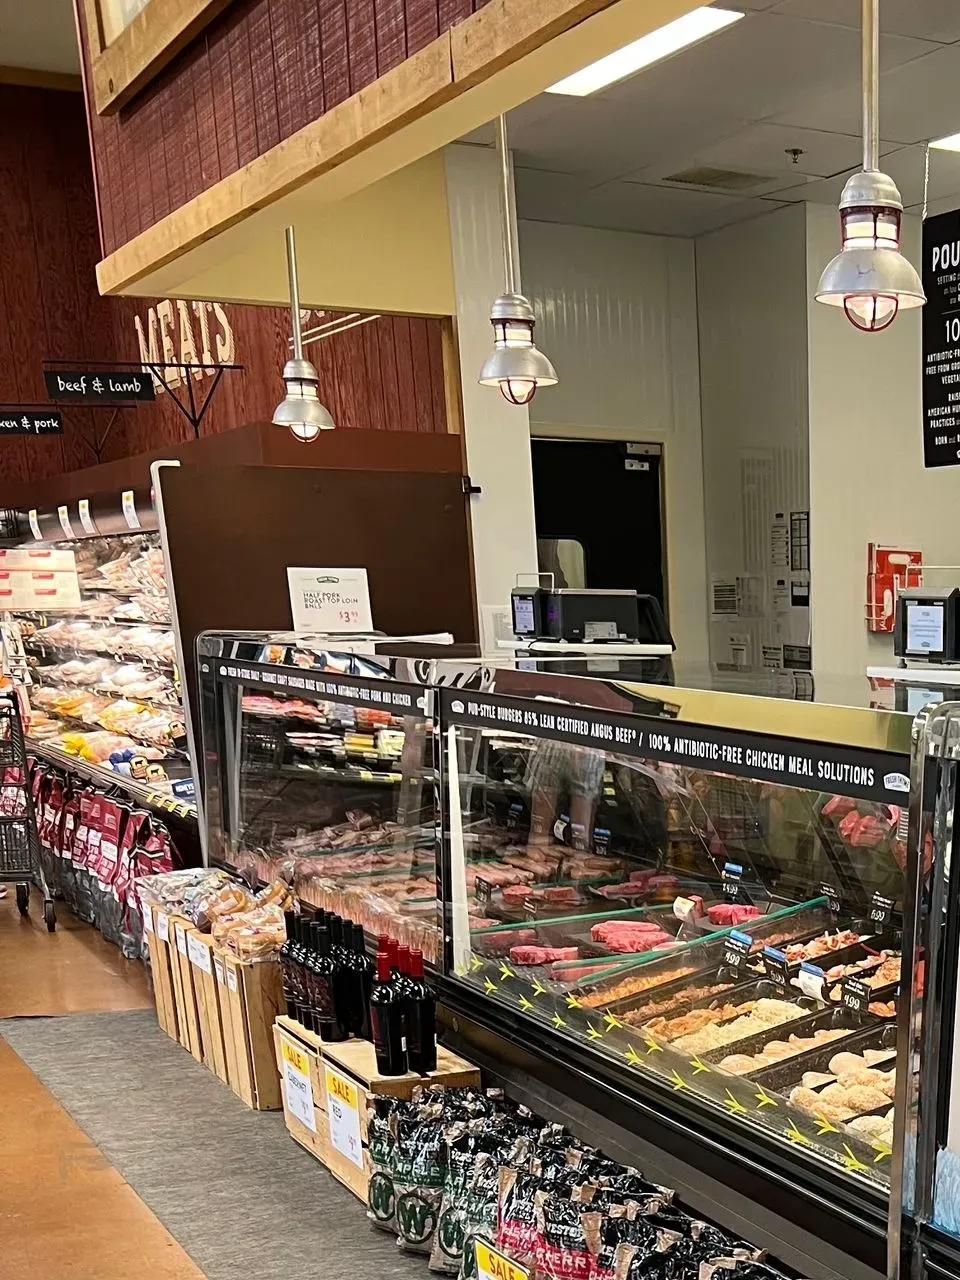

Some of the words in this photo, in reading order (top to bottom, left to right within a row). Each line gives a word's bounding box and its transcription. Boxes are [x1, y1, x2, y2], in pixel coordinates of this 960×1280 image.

[134, 299, 235, 395] MEATS
[57, 375, 87, 399] beef
[92, 377, 104, 394] &
[109, 377, 142, 392] lamb
[21, 416, 30, 429] &
[35, 419, 59, 433] pork
[497, 708, 522, 724] BURGERS
[540, 715, 555, 729] LEAN
[556, 718, 589, 736] CERTIFIED
[591, 724, 613, 740] ANGUS
[648, 733, 671, 752] 100%
[673, 737, 743, 765] ANTIBIOTIC-FREE
[746, 749, 784, 772] CHICKEN
[788, 756, 814, 776] MEAL
[817, 761, 875, 786] SOLUTIONS
[287, 1046, 302, 1070] SALE
[332, 1077, 350, 1103] SALE
